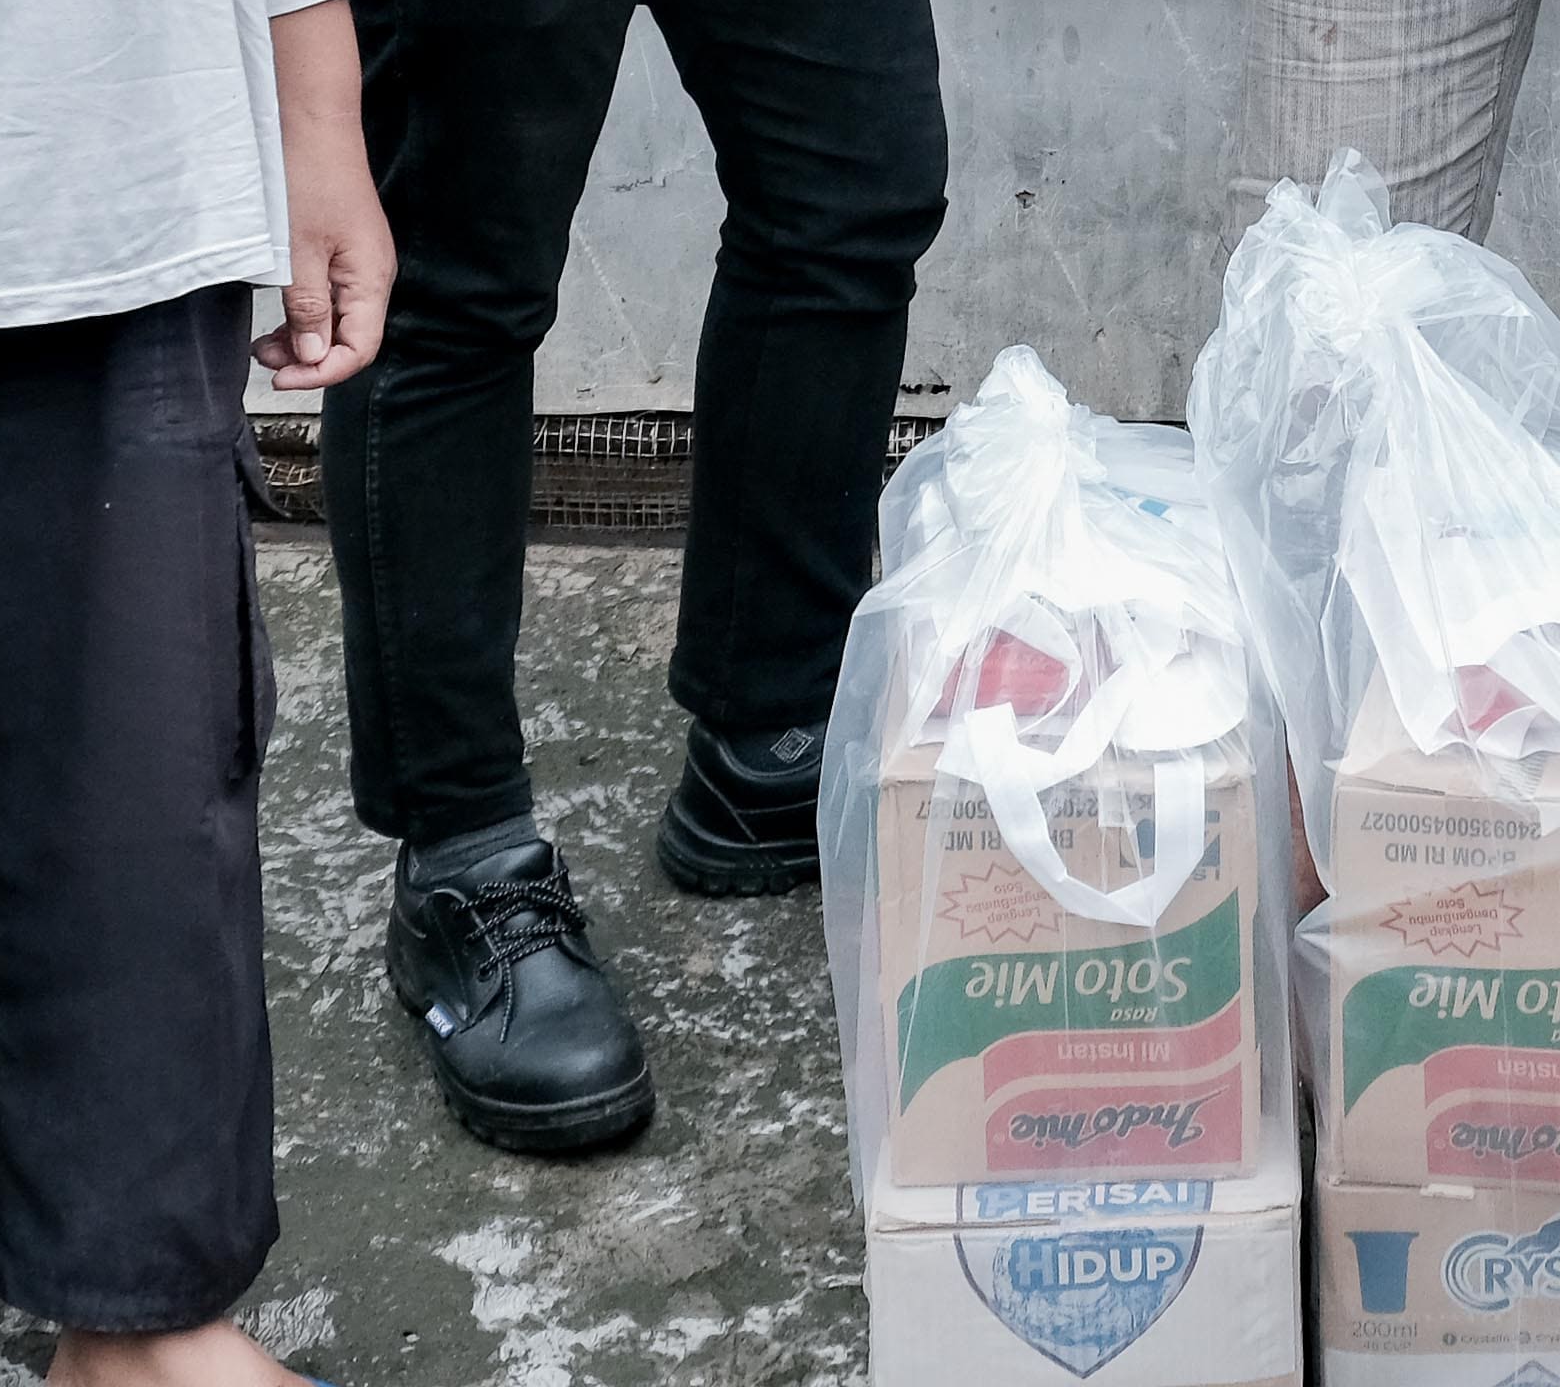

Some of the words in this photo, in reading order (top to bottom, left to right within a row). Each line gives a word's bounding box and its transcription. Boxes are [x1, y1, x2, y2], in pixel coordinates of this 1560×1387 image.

[1384, 842, 1418, 864] MD
[1424, 843, 1443, 866] RI
[1428, 921, 1483, 938] Lengkap
[964, 959, 1059, 1009] Mie
[1074, 956, 1193, 1004] Soto
[1407, 972, 1502, 1020] Mie
[1109, 1006, 1159, 1023] Rasa
[1057, 1041, 1136, 1063] Instan
[976, 1181, 1189, 1219] PERISAI
[1014, 1244, 1177, 1286] HIDUP
[1352, 1319, 1418, 1338] 200ml
